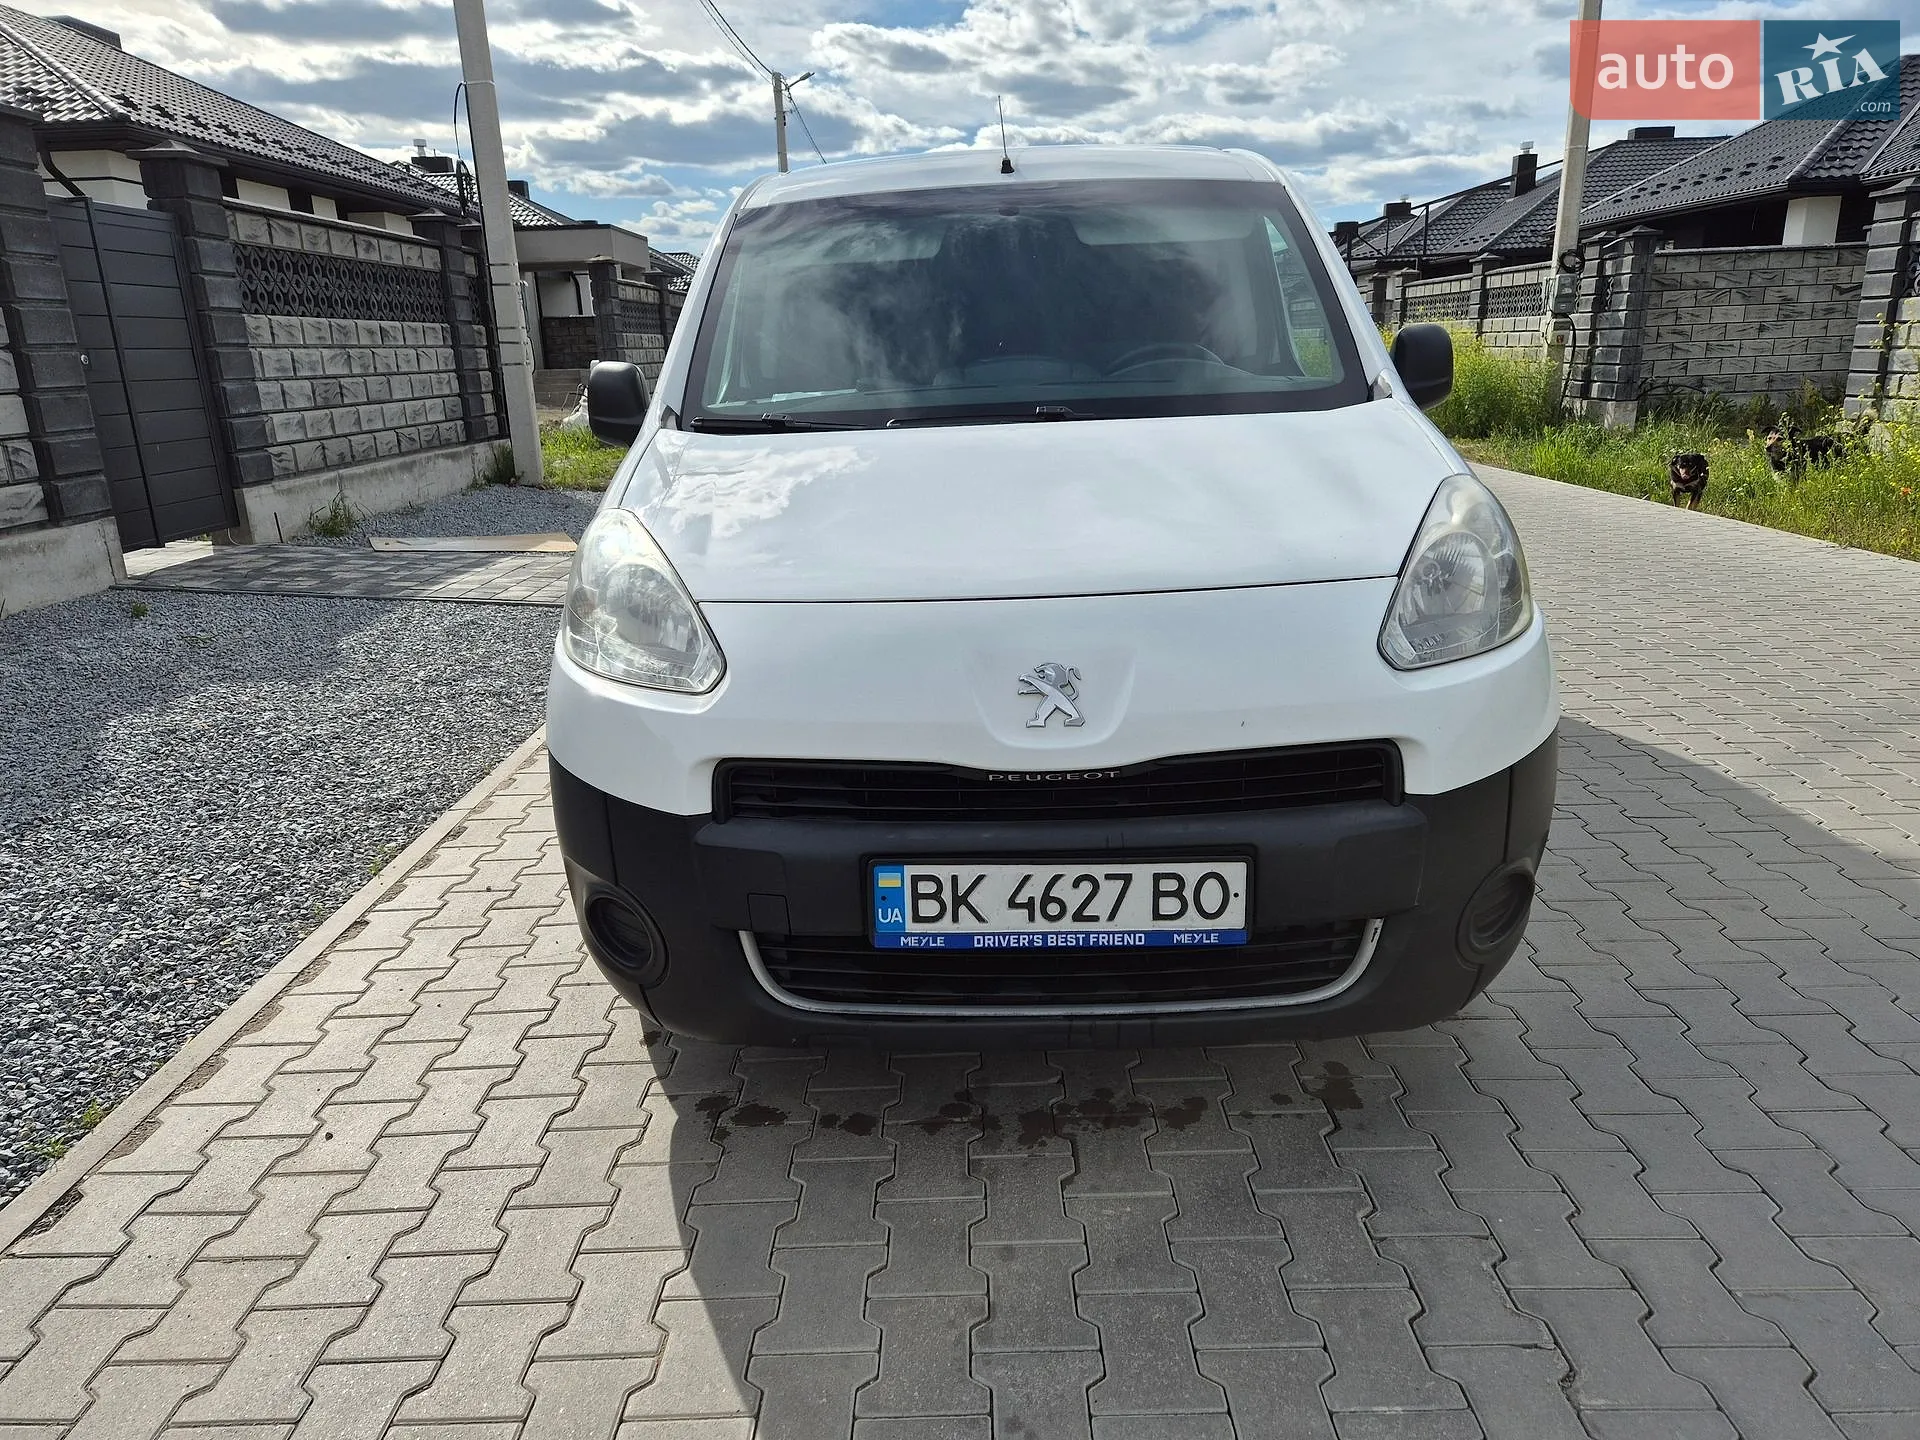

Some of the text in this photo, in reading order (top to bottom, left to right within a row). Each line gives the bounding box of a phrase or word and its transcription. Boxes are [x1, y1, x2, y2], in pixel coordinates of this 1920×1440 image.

[988, 770, 1121, 782] PEUGEOT
[910, 871, 1230, 924] BK 4627 BO
[878, 908, 903, 924] UA
[900, 933, 1219, 948] MEYLE DRIVER'S BEST FRIEND MEYLE
